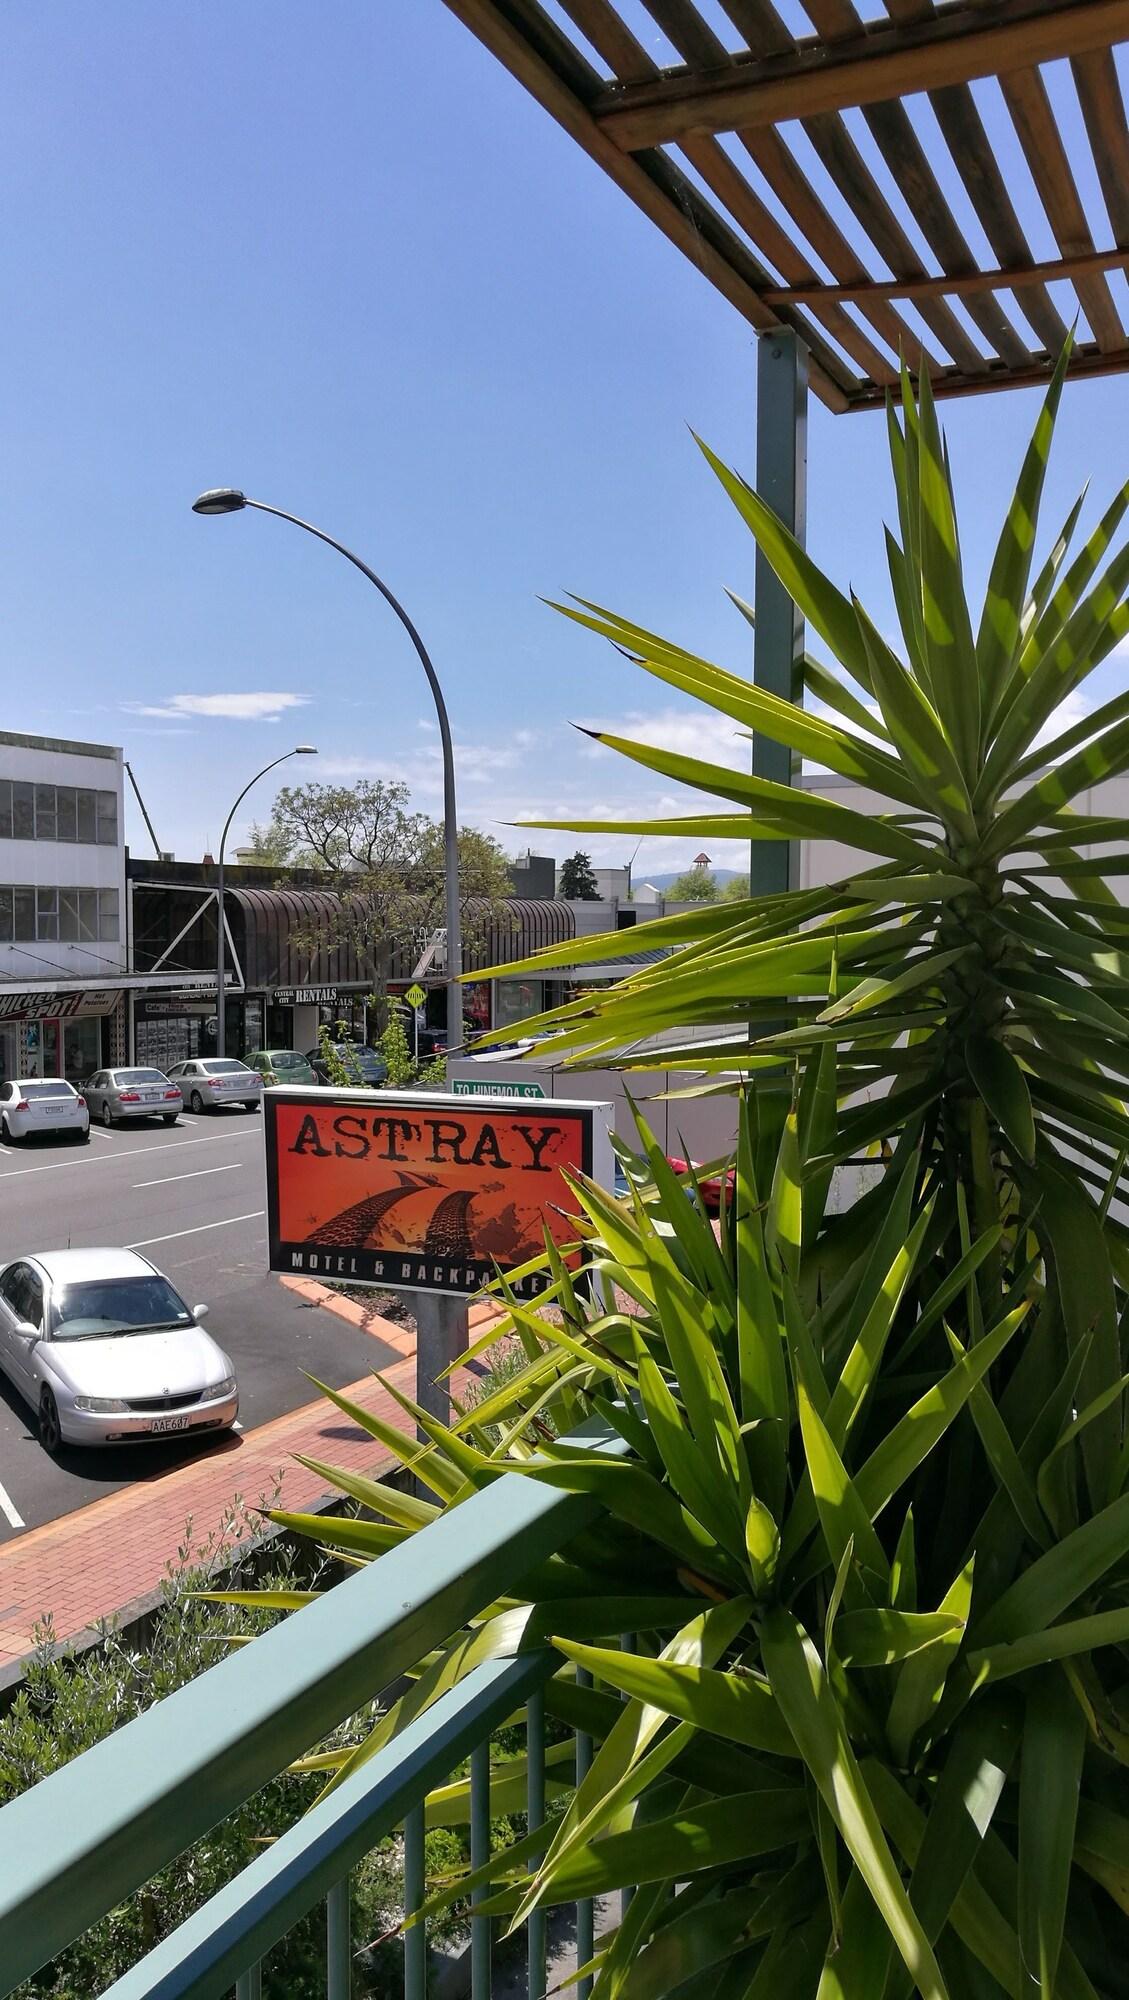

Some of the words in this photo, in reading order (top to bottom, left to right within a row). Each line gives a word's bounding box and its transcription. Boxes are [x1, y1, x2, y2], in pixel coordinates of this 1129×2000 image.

[0, 993, 57, 1016] HICKEN
[296, 988, 337, 1003] RENTALS
[456, 1084, 470, 1096] TO
[473, 1085, 520, 1098] HINEMOA
[524, 1087, 539, 1099] ST
[287, 1113, 562, 1173] ASTRAY
[291, 1251, 357, 1274] MOTEL
[374, 1260, 385, 1276] &
[401, 1263, 555, 1294] BACKPAKE
